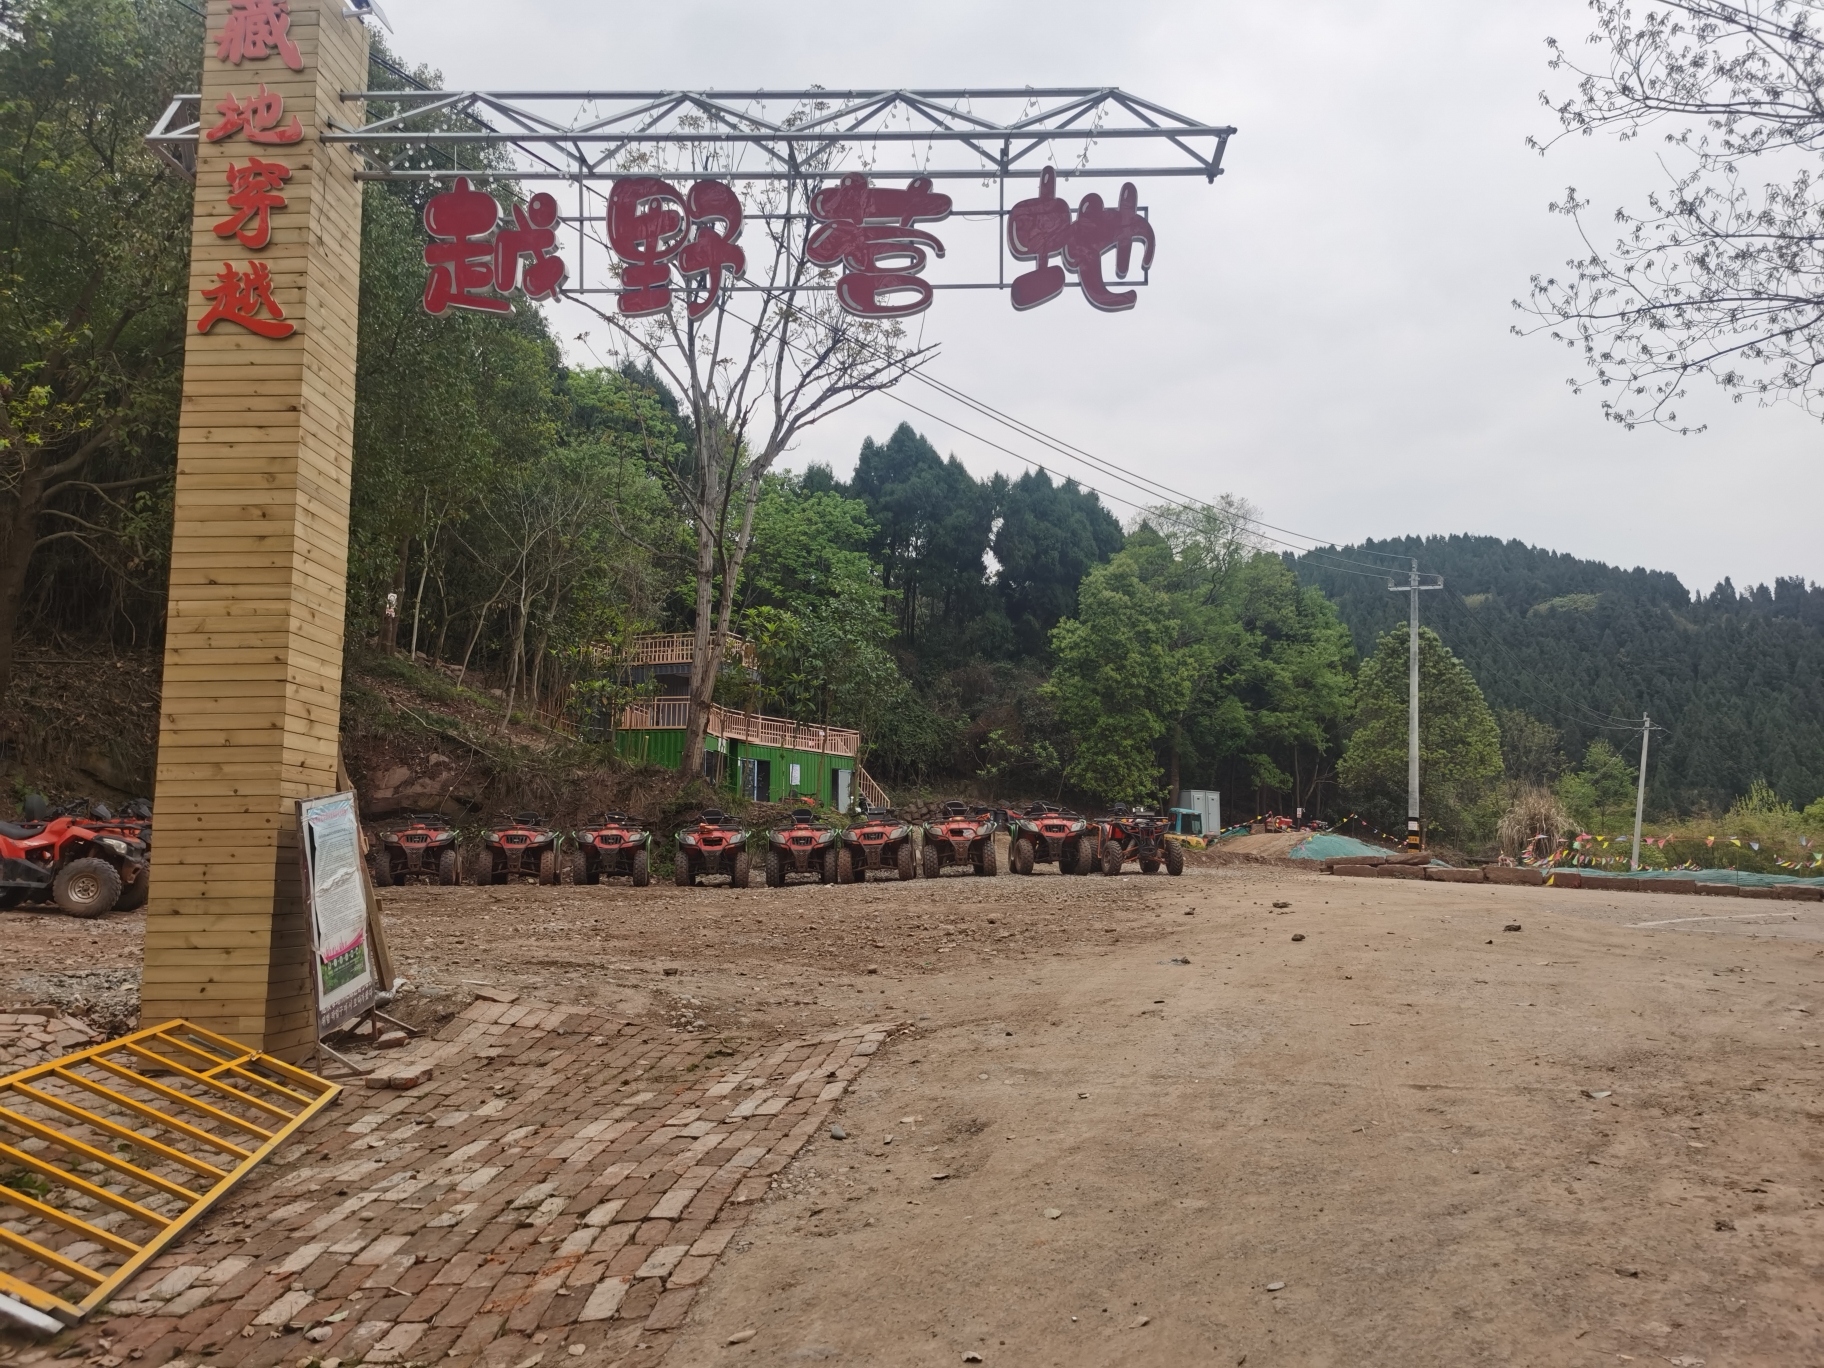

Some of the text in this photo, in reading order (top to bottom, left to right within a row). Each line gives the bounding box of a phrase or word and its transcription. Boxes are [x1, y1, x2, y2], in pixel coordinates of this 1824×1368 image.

[197, 0, 304, 338] 藏地穿越
[423, 165, 1156, 320] 越野营地
